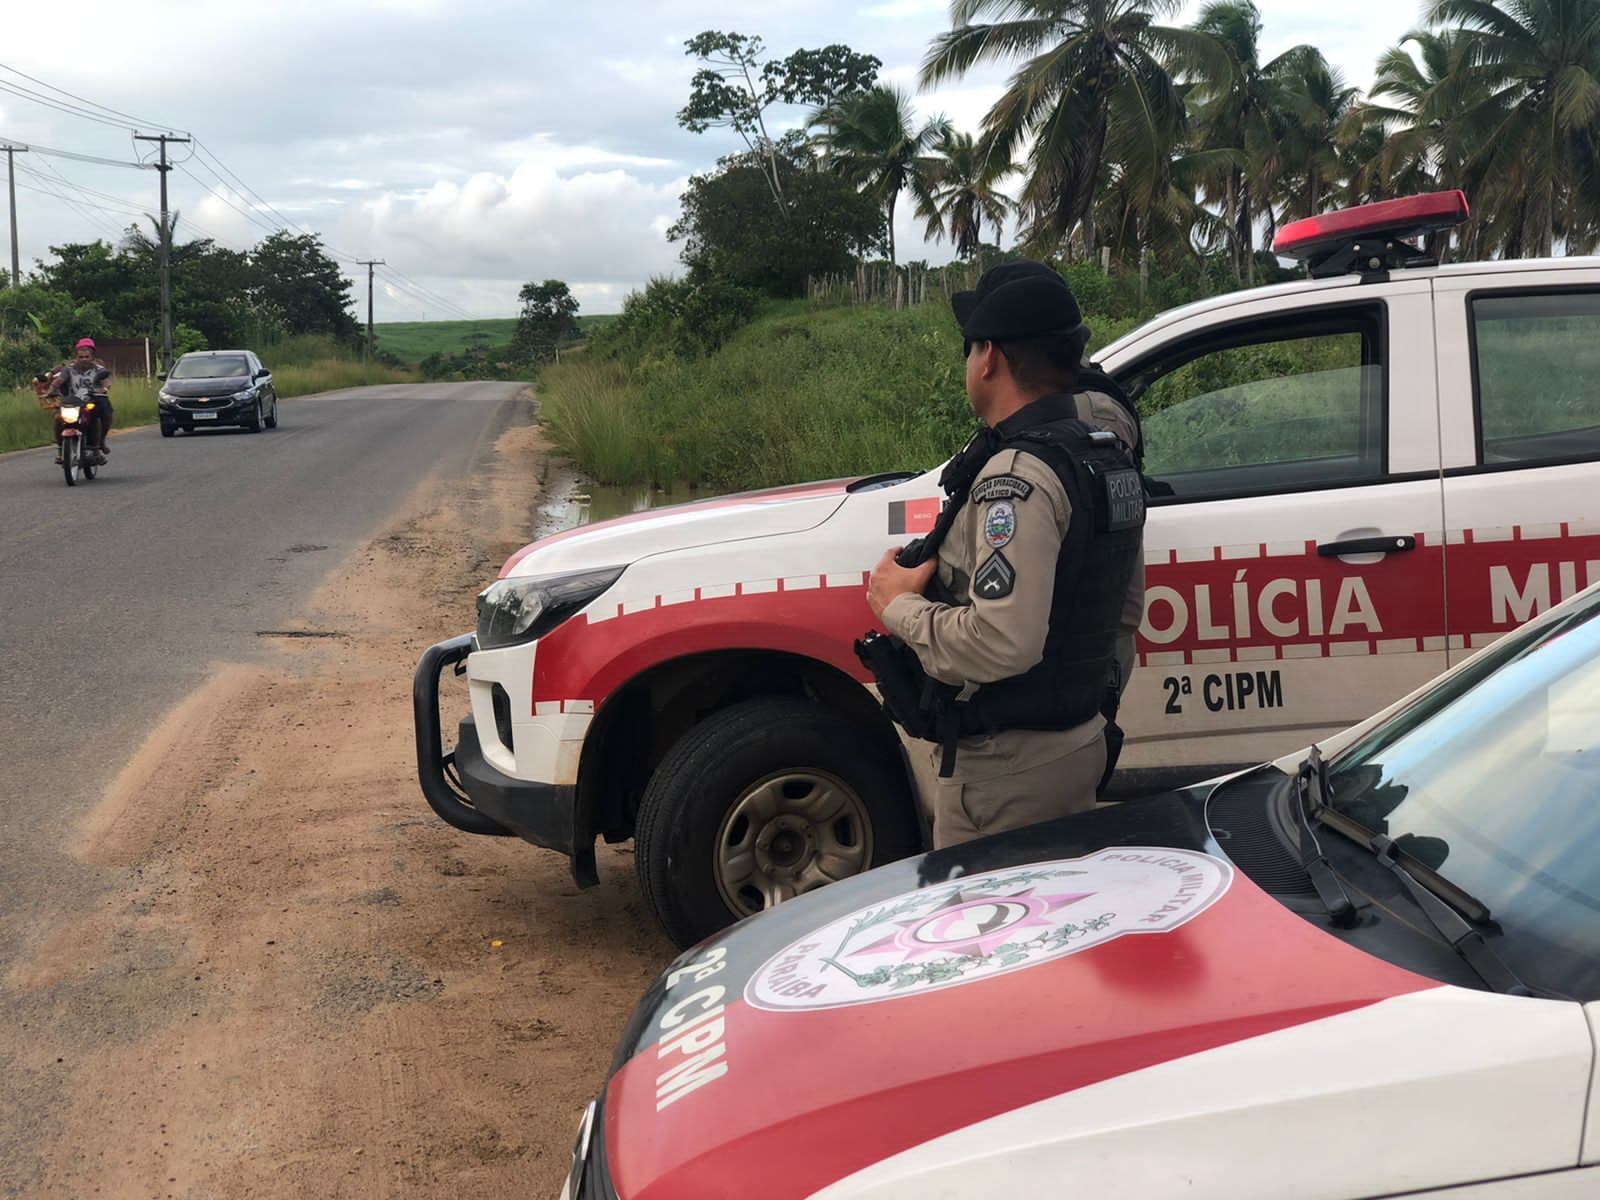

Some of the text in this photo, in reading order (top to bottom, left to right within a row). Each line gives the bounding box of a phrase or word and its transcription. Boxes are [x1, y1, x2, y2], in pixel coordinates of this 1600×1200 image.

[1138, 568, 1383, 645] OLÍCIA
[1203, 670, 1284, 712] CIPM
[1138, 873, 1204, 923] MILITAR
[656, 985, 728, 1112] CIPM
